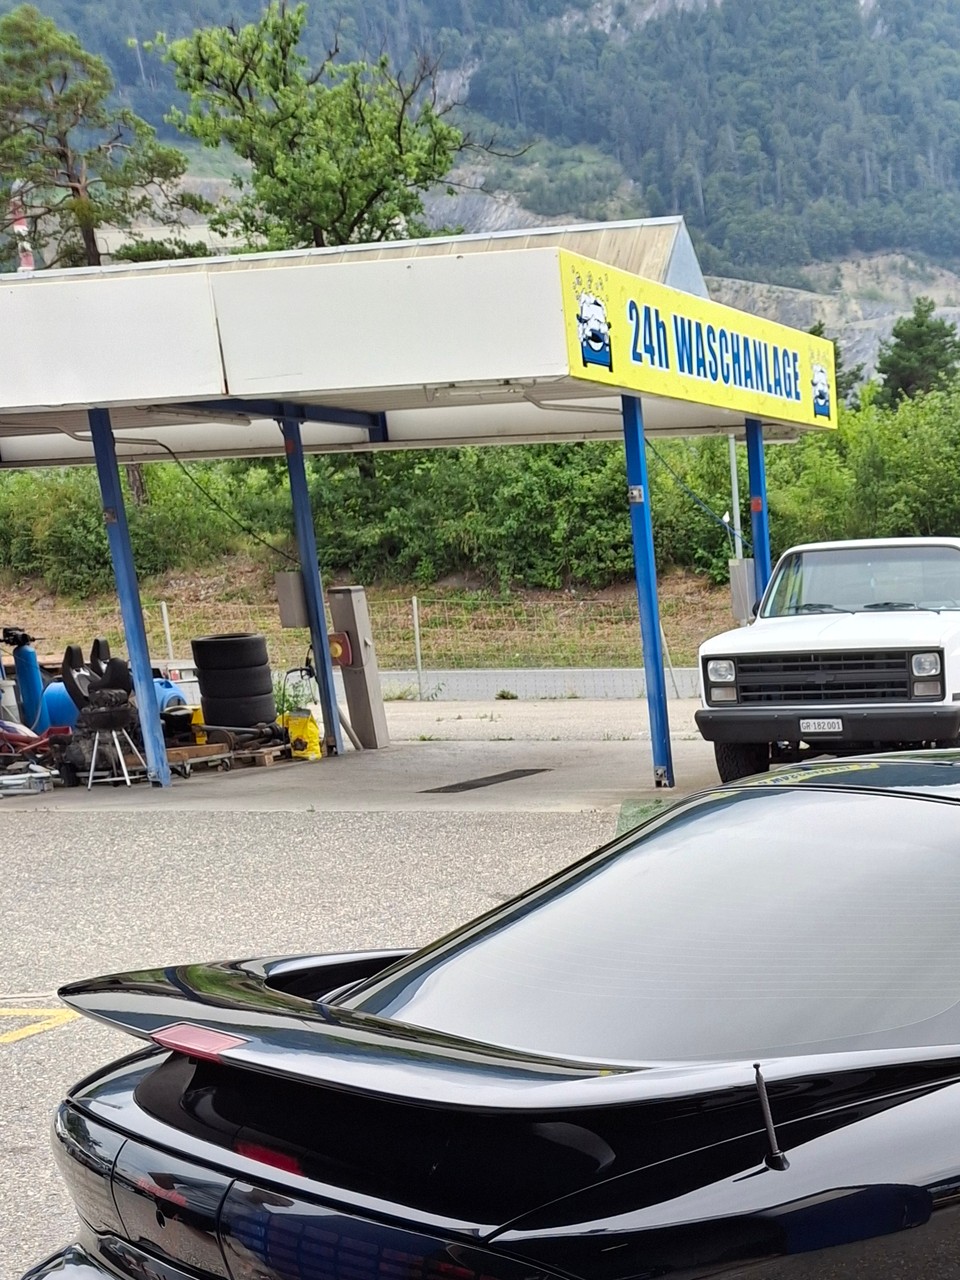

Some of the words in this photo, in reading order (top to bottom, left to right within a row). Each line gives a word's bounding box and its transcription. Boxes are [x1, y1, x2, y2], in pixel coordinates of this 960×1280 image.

[629, 300, 669, 370] 24h
[673, 314, 801, 401] WASCHANLAGE
[801, 721, 811, 730] GR
